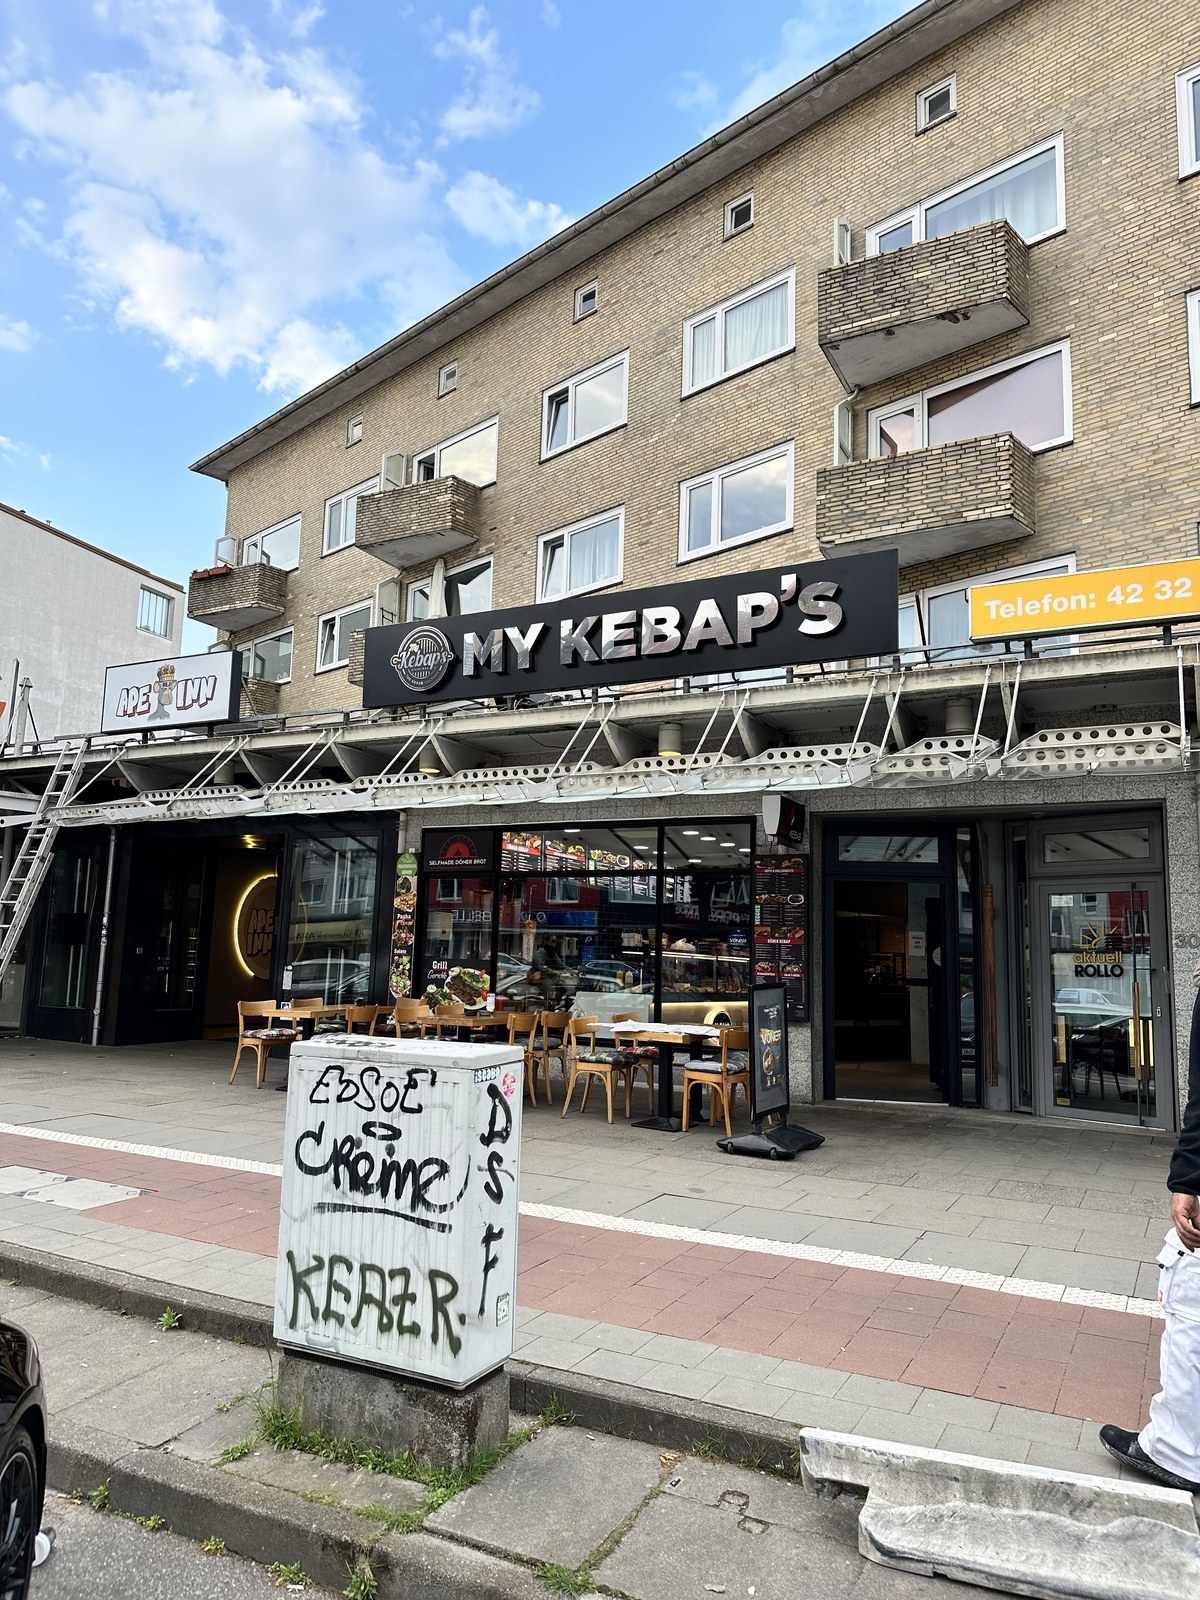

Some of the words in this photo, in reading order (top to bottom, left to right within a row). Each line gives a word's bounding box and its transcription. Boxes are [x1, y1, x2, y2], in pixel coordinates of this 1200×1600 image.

[984, 593, 1096, 620] Telefon:
[1107, 583, 1144, 605] 42
[1154, 577, 1193, 600] 32
[463, 622, 545, 677] MY
[559, 573, 844, 666] KEBAP'S
[116, 684, 152, 717] APE
[176, 675, 217, 710] INN
[432, 960, 448, 969] Grill
[1072, 951, 1124, 963] aktuell
[1074, 964, 1124, 978] ROLLO
